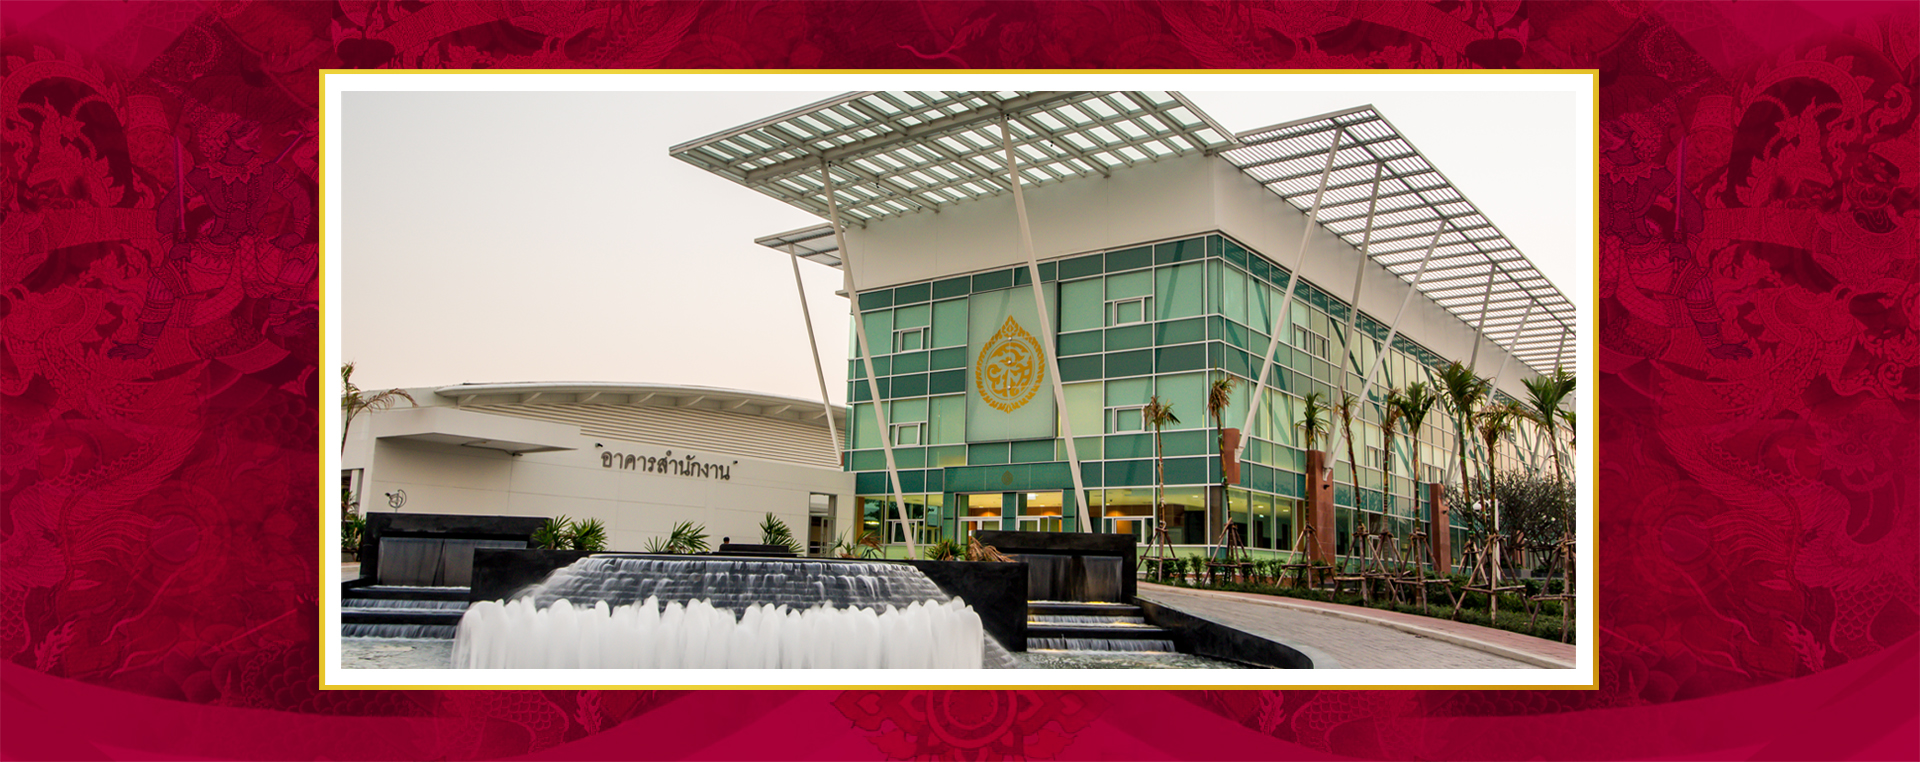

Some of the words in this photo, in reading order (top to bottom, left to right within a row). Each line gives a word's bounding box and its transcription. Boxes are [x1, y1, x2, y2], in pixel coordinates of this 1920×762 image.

[601, 450, 730, 480] อาคารสำนักงาน
